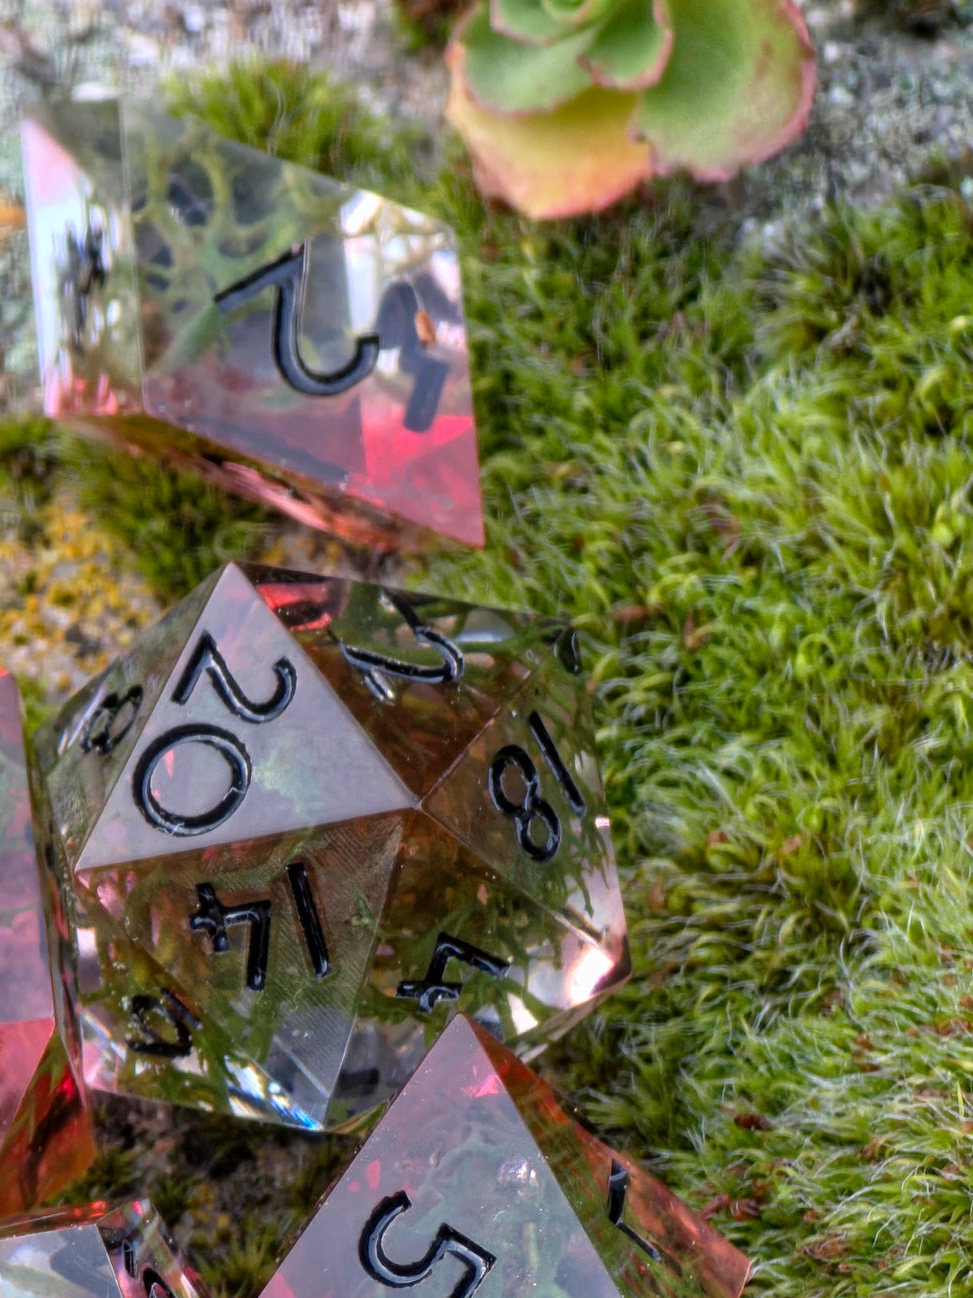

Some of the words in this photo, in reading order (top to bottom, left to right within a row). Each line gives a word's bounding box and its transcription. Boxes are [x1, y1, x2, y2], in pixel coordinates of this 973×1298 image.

[133, 629, 298, 837] 20
[487, 711, 587, 863] 18
[190, 862, 331, 992] 14
